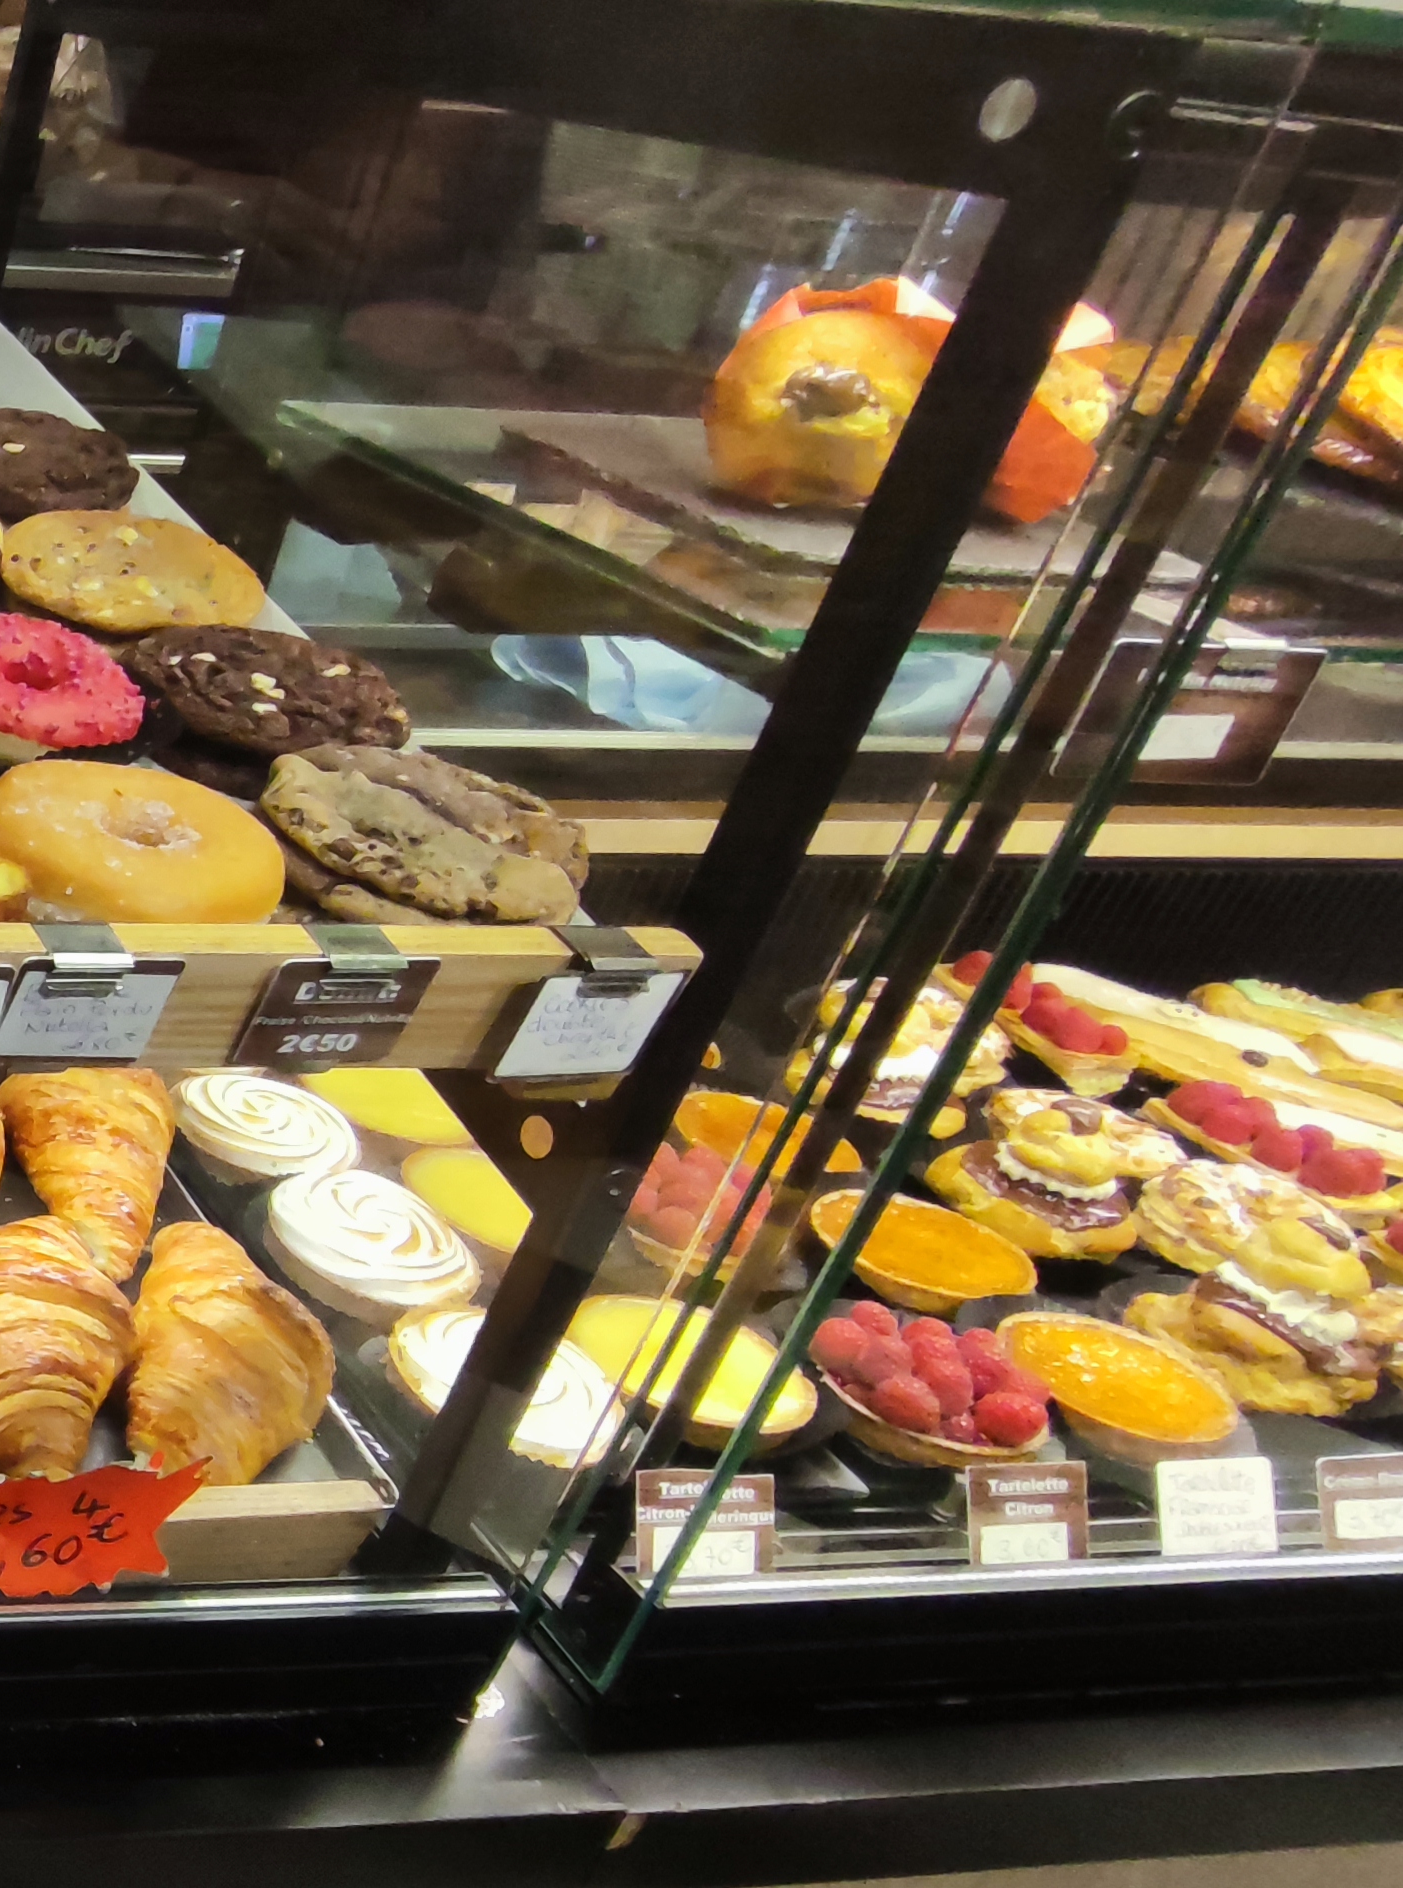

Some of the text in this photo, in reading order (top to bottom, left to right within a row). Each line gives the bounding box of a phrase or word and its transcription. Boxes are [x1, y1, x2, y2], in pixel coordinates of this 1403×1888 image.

[54, 326, 133, 363] Chef
[276, 1033, 359, 1054] 2€50
[659, 1480, 755, 1500] Tarteette
[987, 1477, 1069, 1494] Tartelette
[71, 1489, 110, 1519] 4
[1004, 1501, 1054, 1516] Citron
